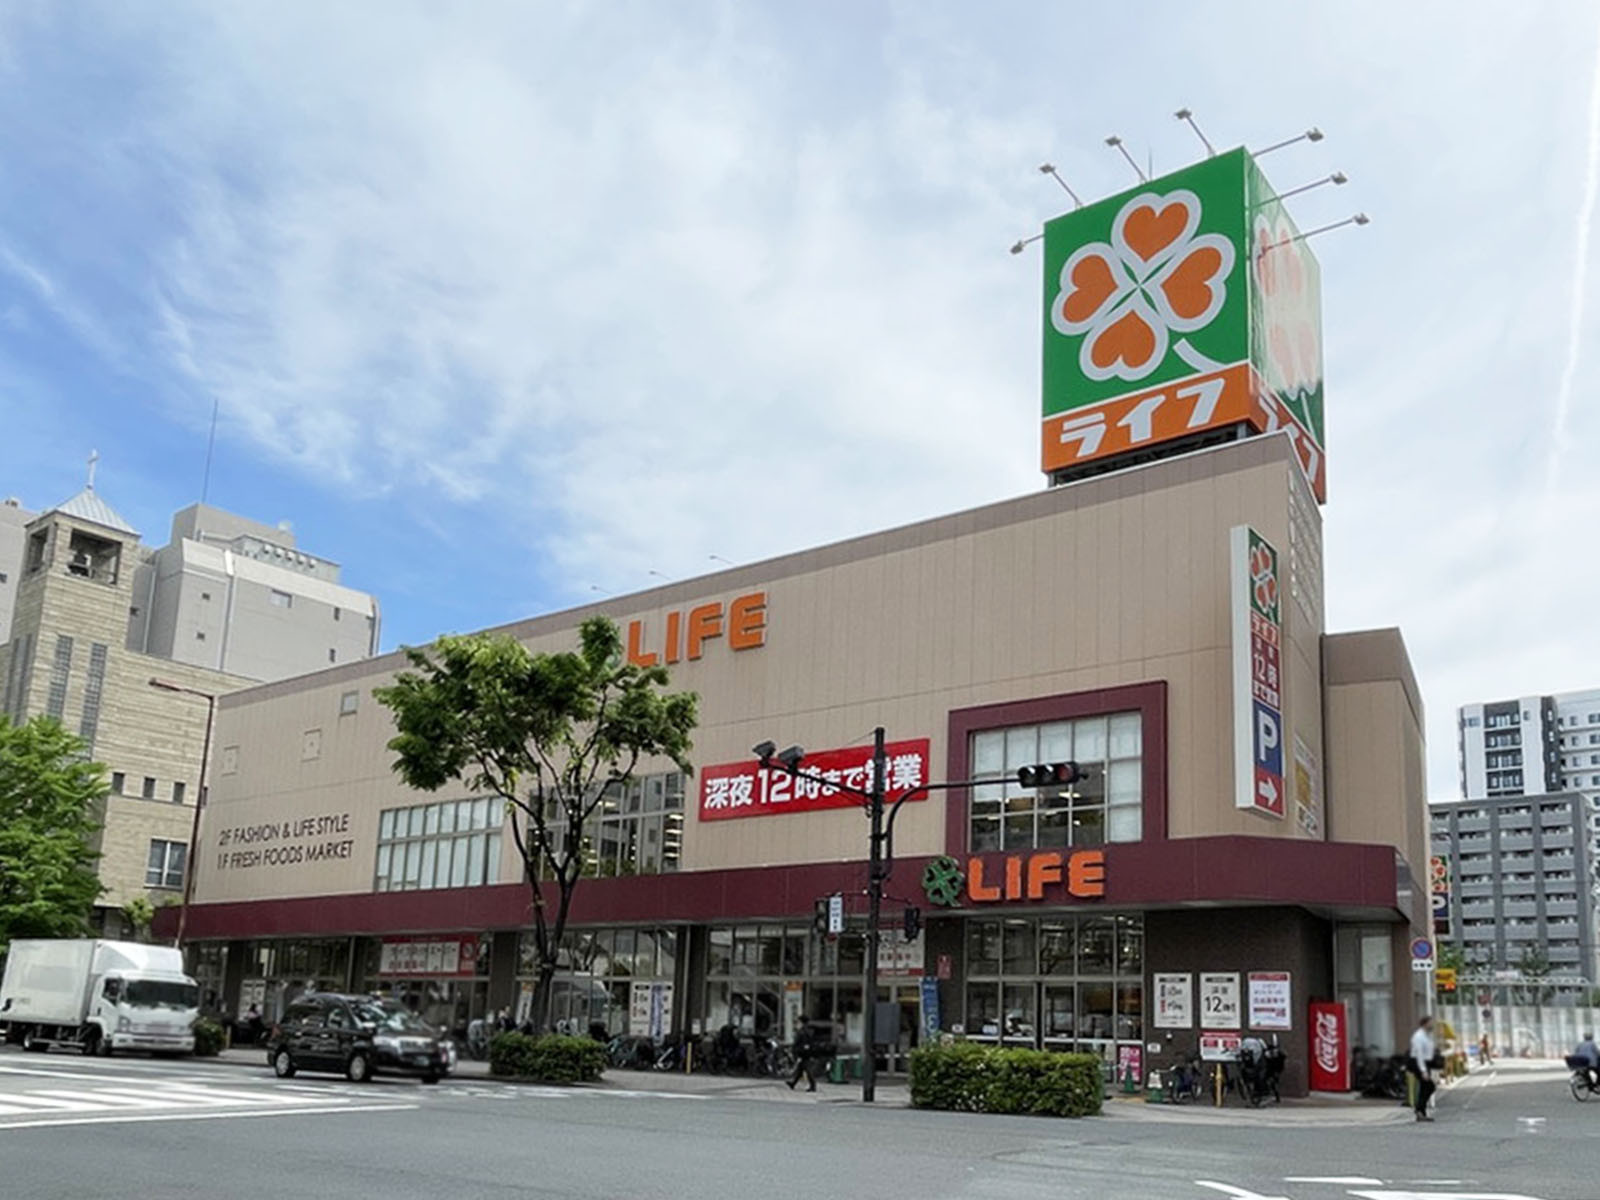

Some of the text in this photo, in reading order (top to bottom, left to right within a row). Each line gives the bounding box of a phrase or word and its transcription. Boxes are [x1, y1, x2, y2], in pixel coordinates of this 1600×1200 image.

[1060, 378, 1225, 458] ライフ
[628, 592, 766, 668] LIFE
[1258, 710, 1278, 761] P
[704, 754, 922, 809] 深夜12時まで営業
[217, 840, 354, 870] 1F FRESH FOODS MARKET
[219, 828, 231, 847] 2F
[233, 824, 281, 843] FASHION
[282, 821, 291, 839] &
[968, 851, 1105, 901] LIFE
[1316, 1011, 1339, 1073] Coca-Cola
